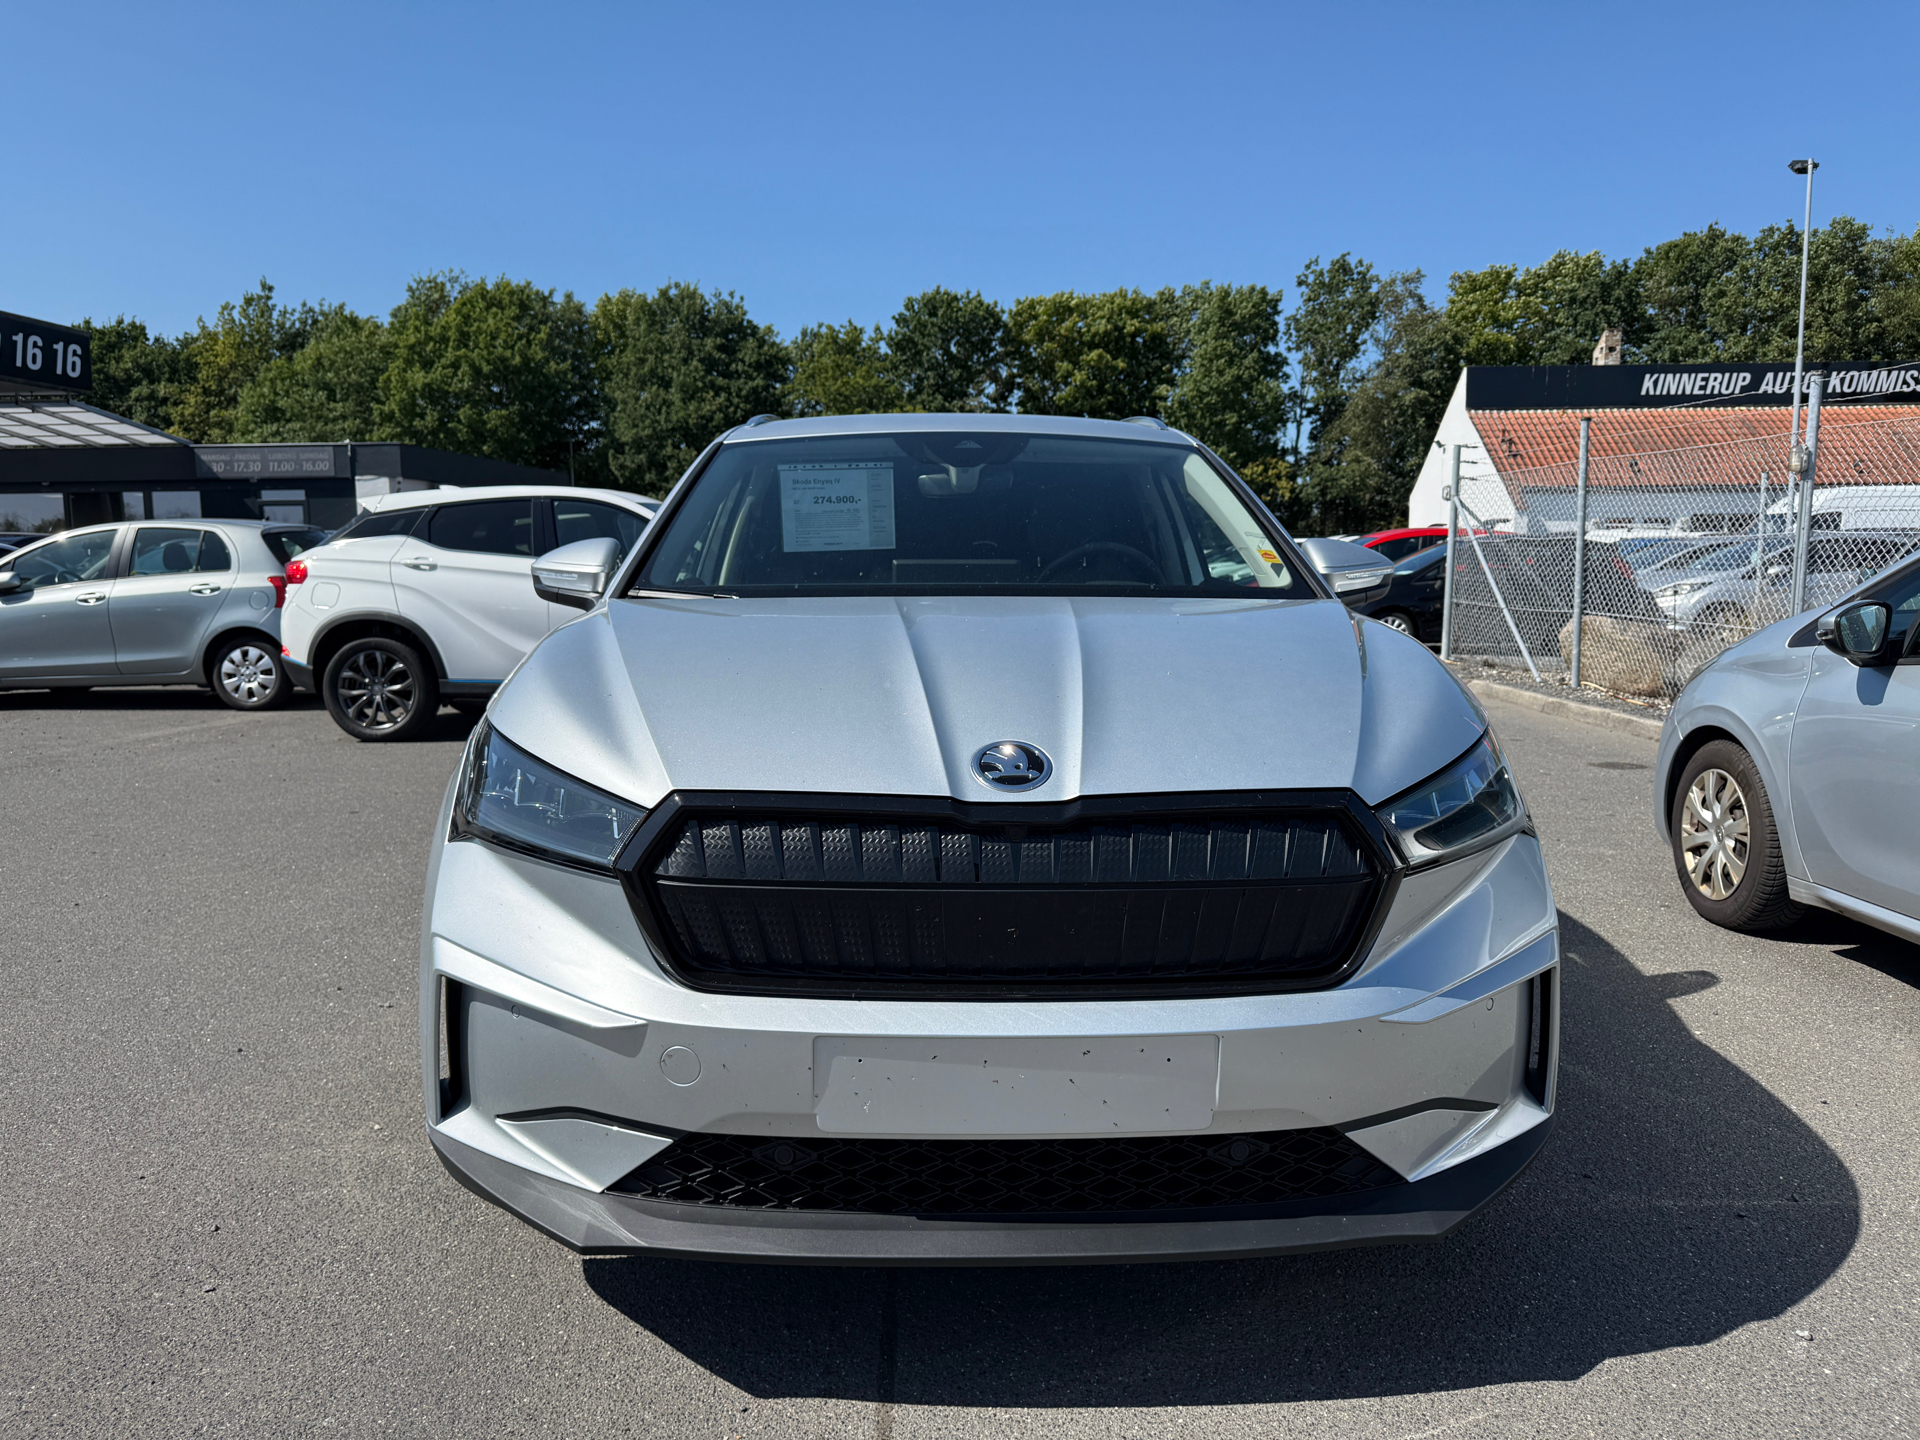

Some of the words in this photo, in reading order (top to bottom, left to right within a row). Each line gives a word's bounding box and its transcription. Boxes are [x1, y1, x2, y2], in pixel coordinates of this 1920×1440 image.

[12, 332, 43, 371] 16
[53, 341, 82, 378] 16
[1641, 372, 1751, 395] KINNERUP
[233, 461, 262, 472] 17.30
[269, 461, 295, 472] 11.00
[302, 460, 330, 471] 16.00
[813, 495, 861, 504] 274.900,-
